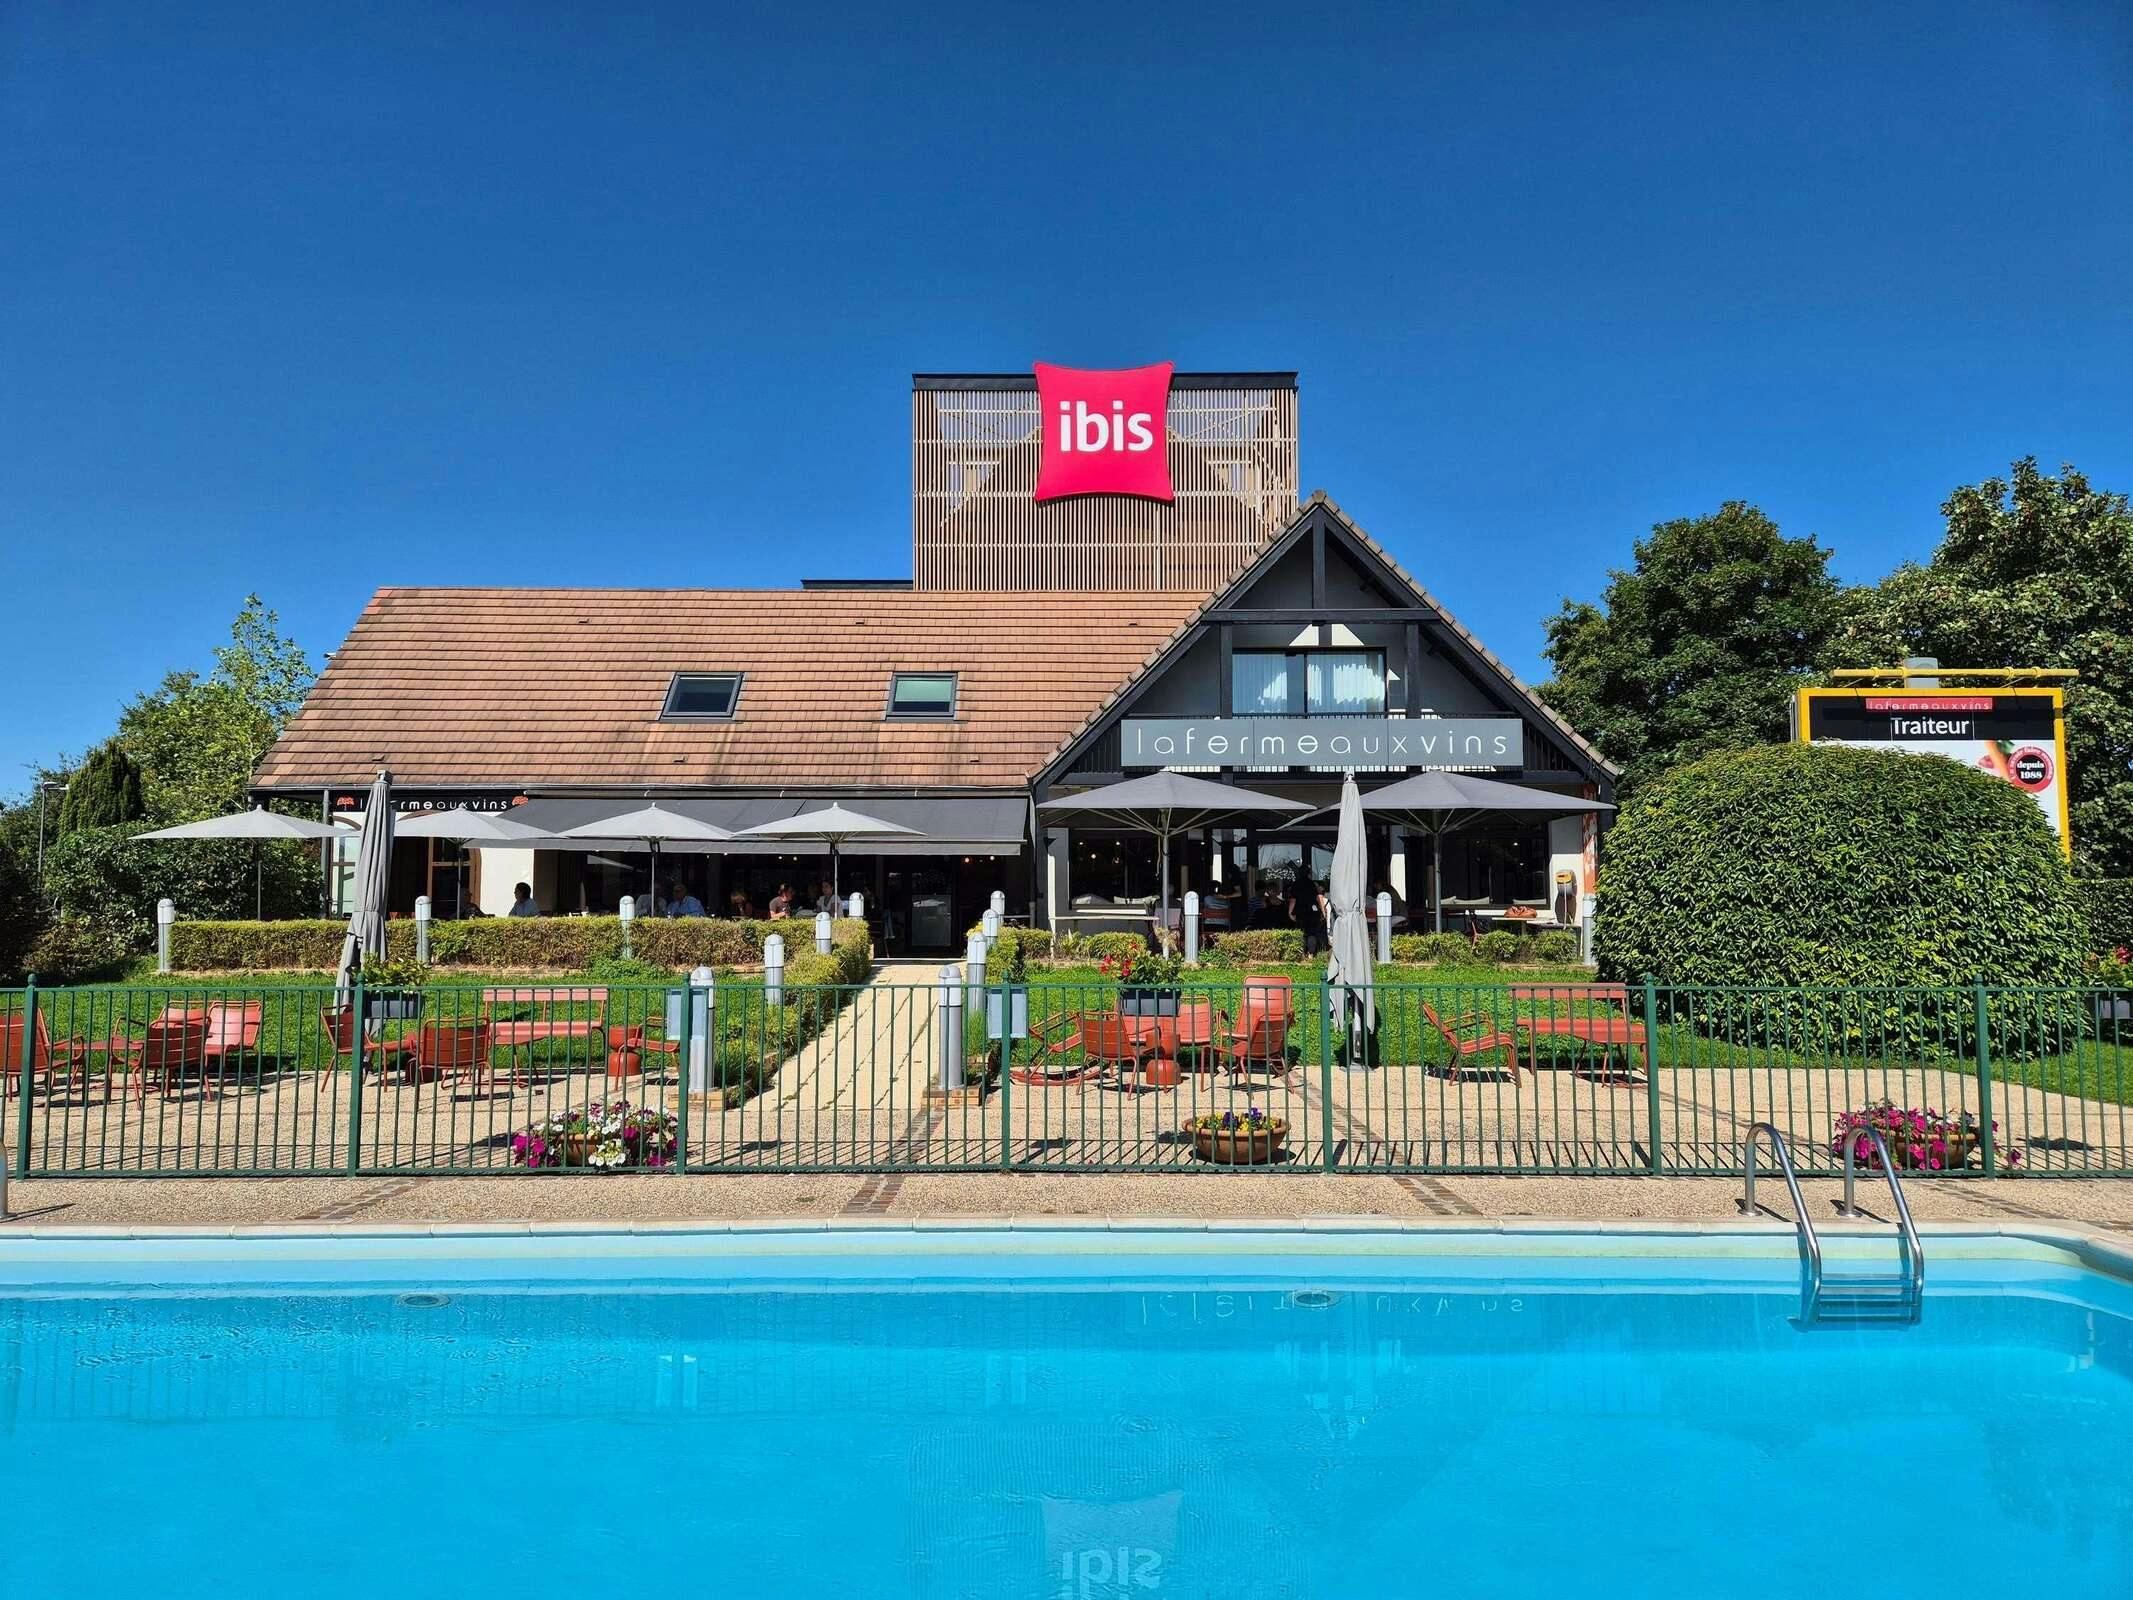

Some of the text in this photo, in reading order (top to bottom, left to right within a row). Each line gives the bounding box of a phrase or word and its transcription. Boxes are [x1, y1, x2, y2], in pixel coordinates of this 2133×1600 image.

[1059, 400, 1154, 452] ibis
[1869, 700, 1990, 710] lafermeauxvins
[1890, 716, 1970, 735] Traiteur
[1136, 727, 1508, 755] lafermeauxvins
[2016, 760, 2045, 770] depuis
[2020, 771, 2043, 779] 1988
[360, 797, 508, 810] lrmeauxvins
